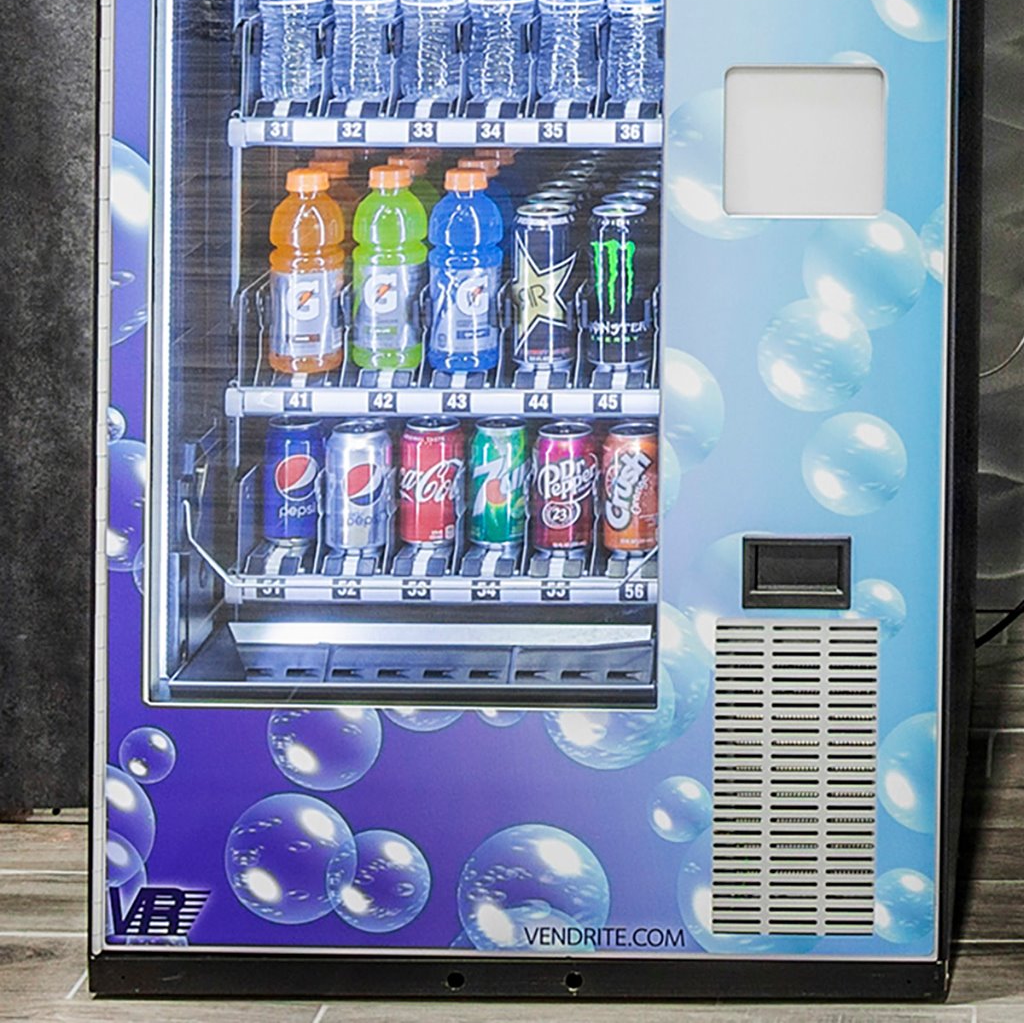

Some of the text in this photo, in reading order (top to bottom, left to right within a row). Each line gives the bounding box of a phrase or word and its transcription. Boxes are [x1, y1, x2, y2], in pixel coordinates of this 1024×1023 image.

[270, 121, 289, 138] 31
[342, 122, 362, 138] 32
[412, 122, 434, 138] 33
[480, 122, 501, 139] 34
[543, 122, 563, 139] 35
[620, 123, 640, 140] 36
[287, 281, 320, 321] G
[364, 274, 398, 314] G
[456, 276, 489, 316] G
[289, 394, 307, 408] 41
[373, 392, 394, 409] 42
[446, 393, 467, 410] 43
[528, 393, 549, 410] 44
[597, 393, 618, 410] 45
[559, 457, 586, 476] Dr
[541, 463, 598, 500] Pepper
[605, 451, 652, 530] Crush
[279, 502, 315, 518] pepsi
[552, 508, 567, 522] 23
[625, 583, 644, 599] 56
[523, 925, 685, 949] VENDRITE.COM
